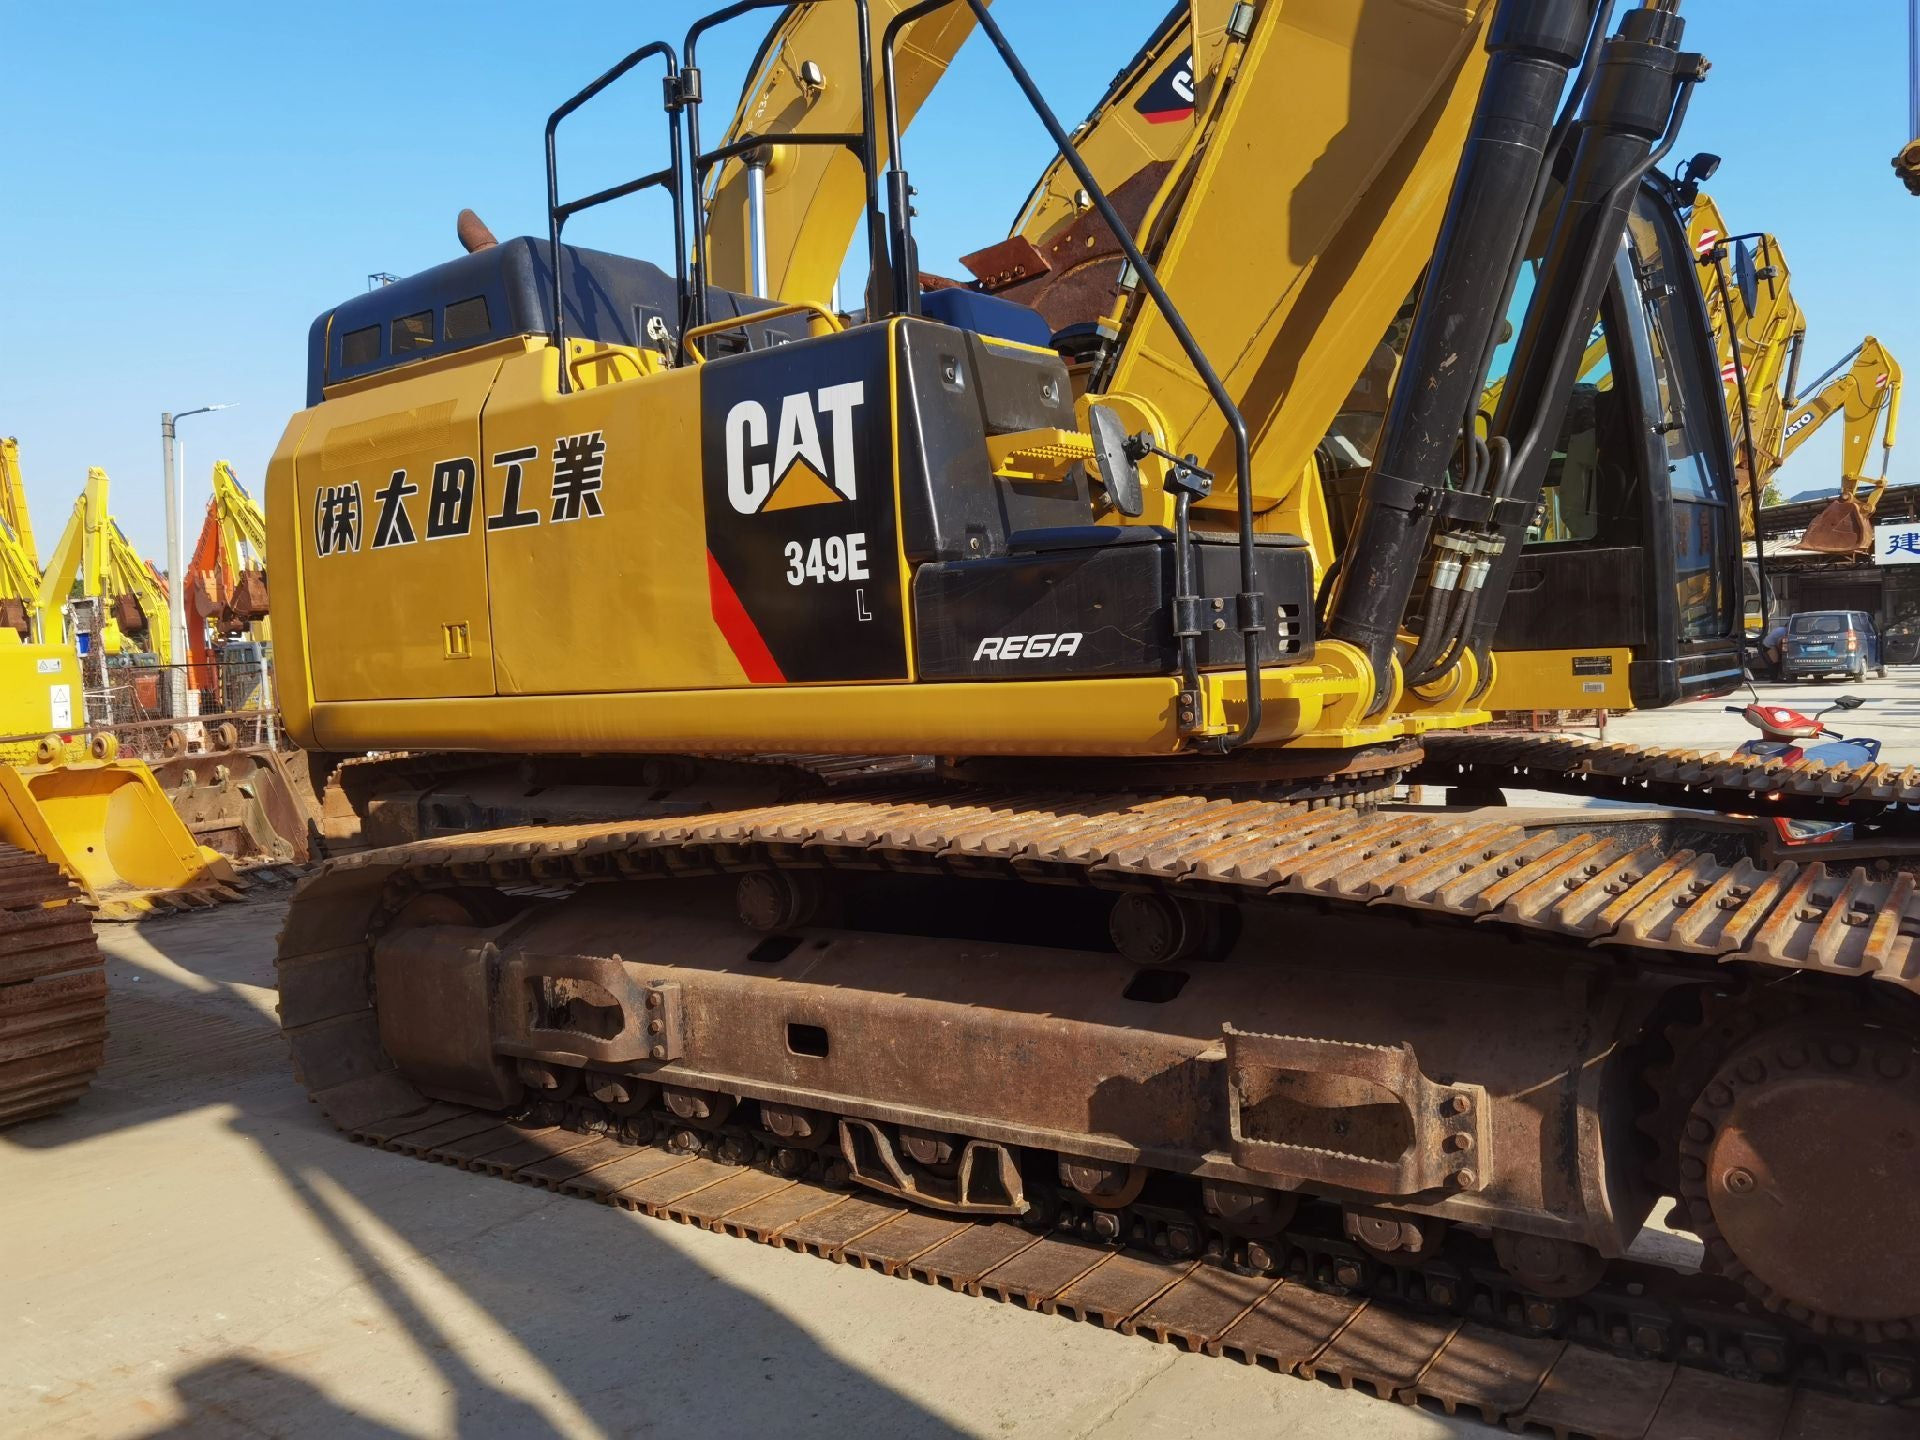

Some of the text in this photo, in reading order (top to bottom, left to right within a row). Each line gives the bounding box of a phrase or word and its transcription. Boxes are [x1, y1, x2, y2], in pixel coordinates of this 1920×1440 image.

[725, 380, 864, 515] CAT
[314, 430, 607, 558] (株)太田工業
[237, 508, 263, 550] SUMITOMO
[1885, 532, 1920, 555] 建
[784, 532, 870, 586] 349E
[856, 588, 873, 622] L
[972, 632, 1084, 662] REGA
